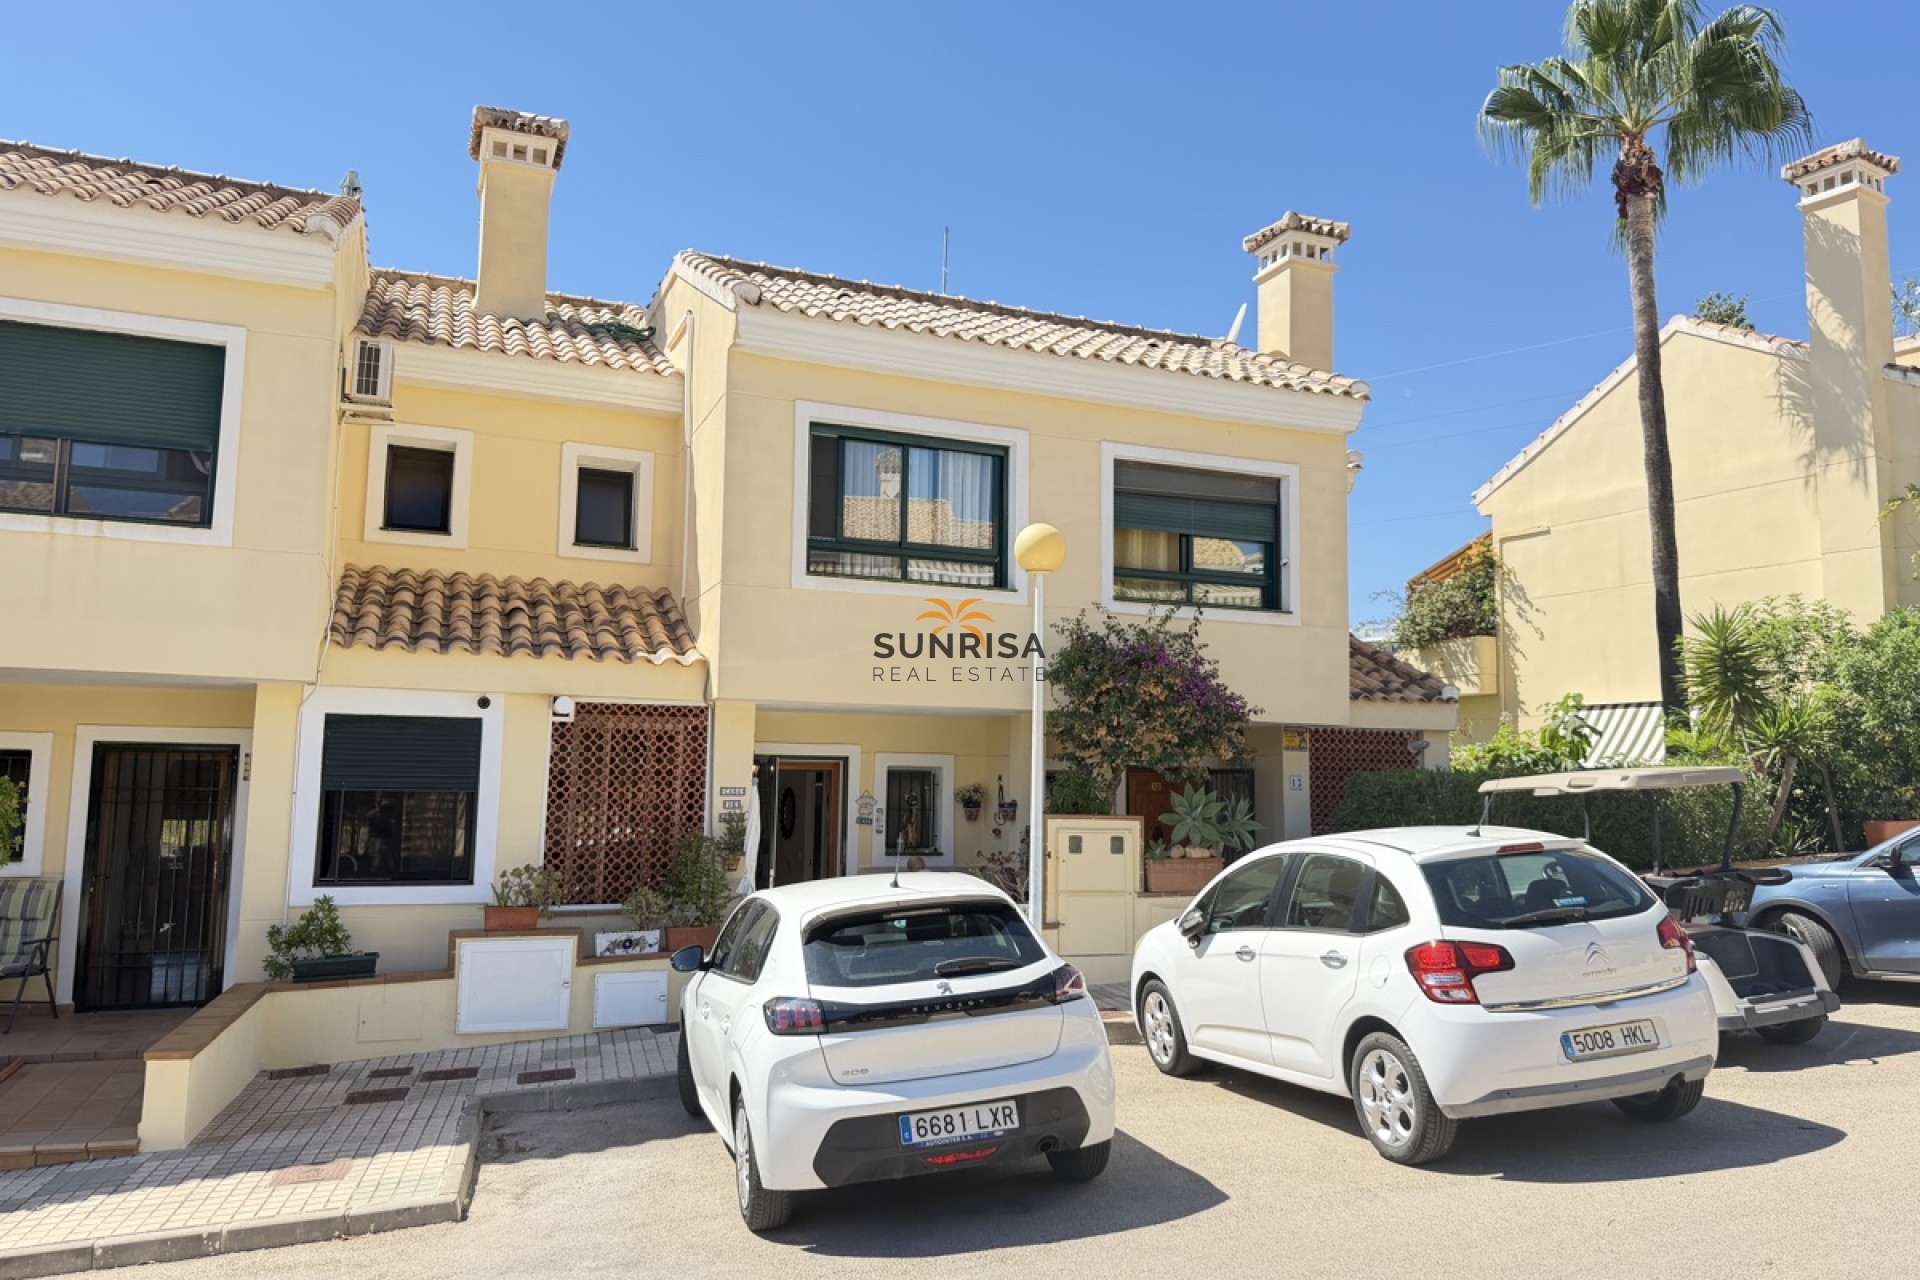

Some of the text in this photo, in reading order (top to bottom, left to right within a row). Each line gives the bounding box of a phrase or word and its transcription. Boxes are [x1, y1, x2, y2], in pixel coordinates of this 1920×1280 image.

[1573, 1025, 1652, 1053] 5008 HKL
[916, 1105, 1015, 1138] 6681 LXR
